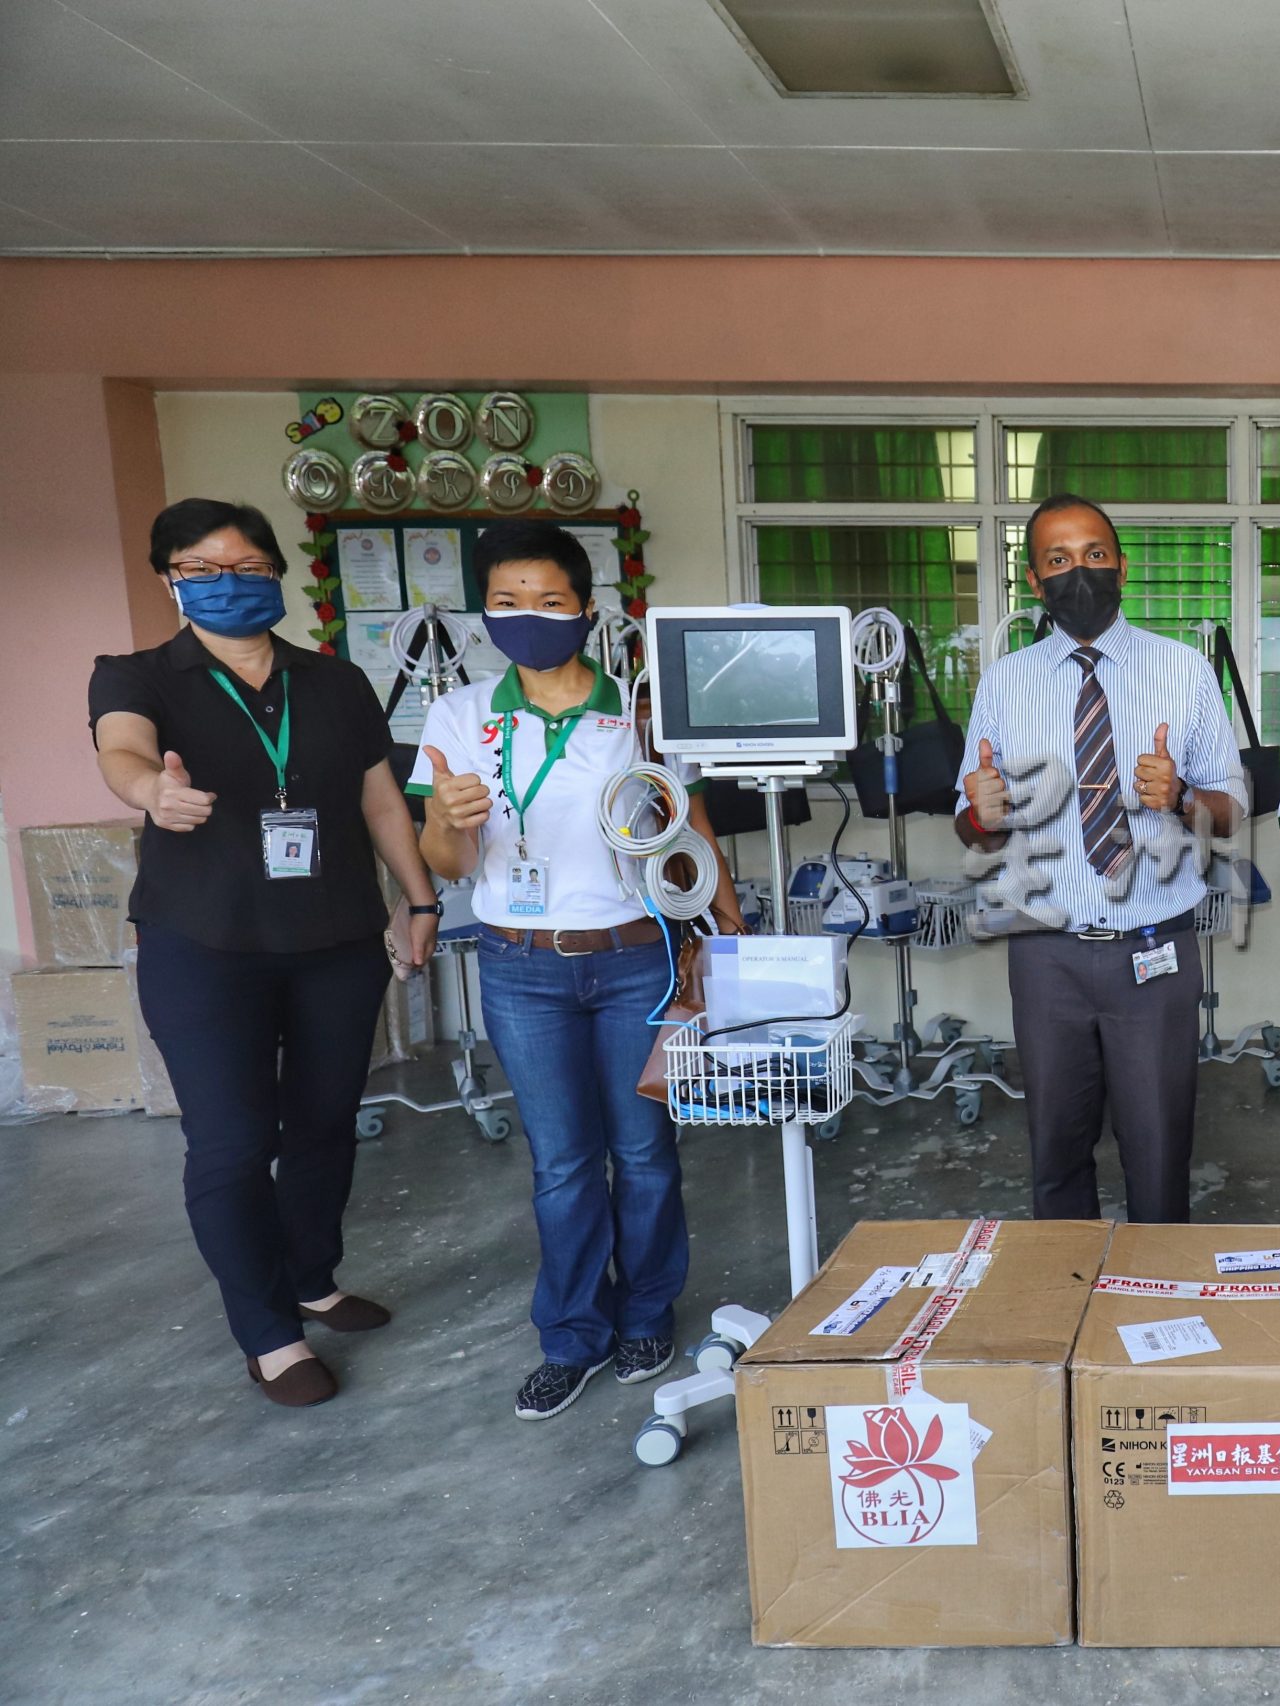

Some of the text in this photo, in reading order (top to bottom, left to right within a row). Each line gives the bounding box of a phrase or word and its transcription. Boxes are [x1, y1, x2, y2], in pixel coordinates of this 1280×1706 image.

[511, 905, 542, 913] MEDIA
[94, 1042, 124, 1051] Fisher
[1110, 1278, 1179, 1291] FRAGILE
[1119, 1440, 1167, 1450] NIHON K
[1102, 1461, 1126, 1478] CE
[1186, 1467, 1240, 1476] YAYASAN
[1245, 1467, 1266, 1475] SIN
[1103, 1477, 1125, 1486] 0123
[857, 1489, 913, 1509] 佛光
[861, 1509, 931, 1527] BLIA
